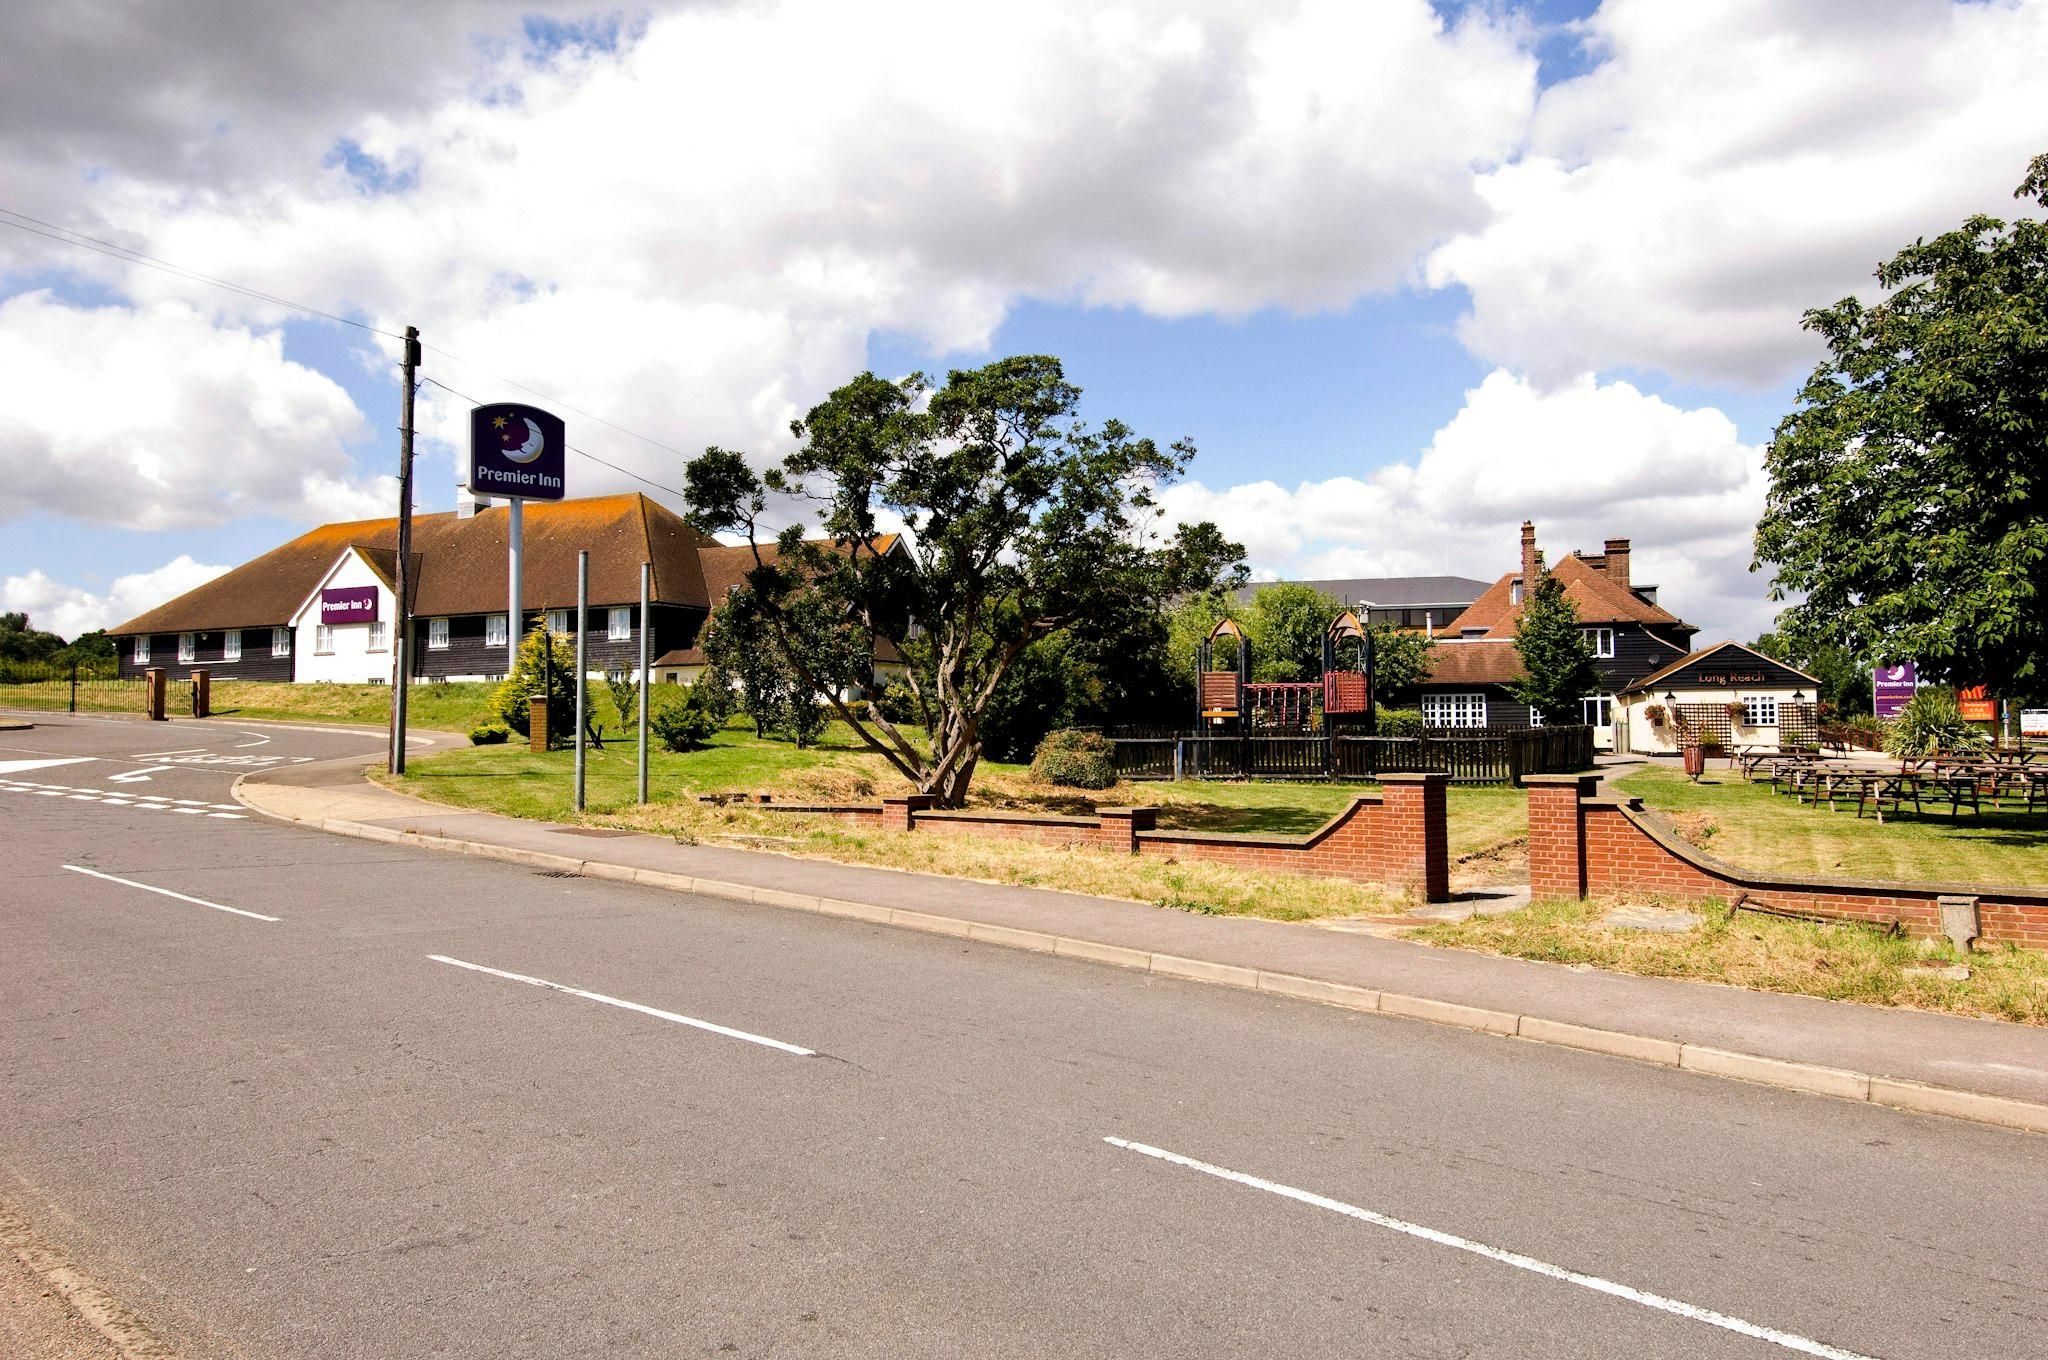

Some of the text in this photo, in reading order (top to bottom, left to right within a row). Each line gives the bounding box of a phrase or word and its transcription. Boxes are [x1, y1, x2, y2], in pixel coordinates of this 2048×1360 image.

[478, 465, 561, 488] Premier Inn
[322, 600, 362, 611] Premier Inn
[1698, 671, 1765, 685] Long Reach
